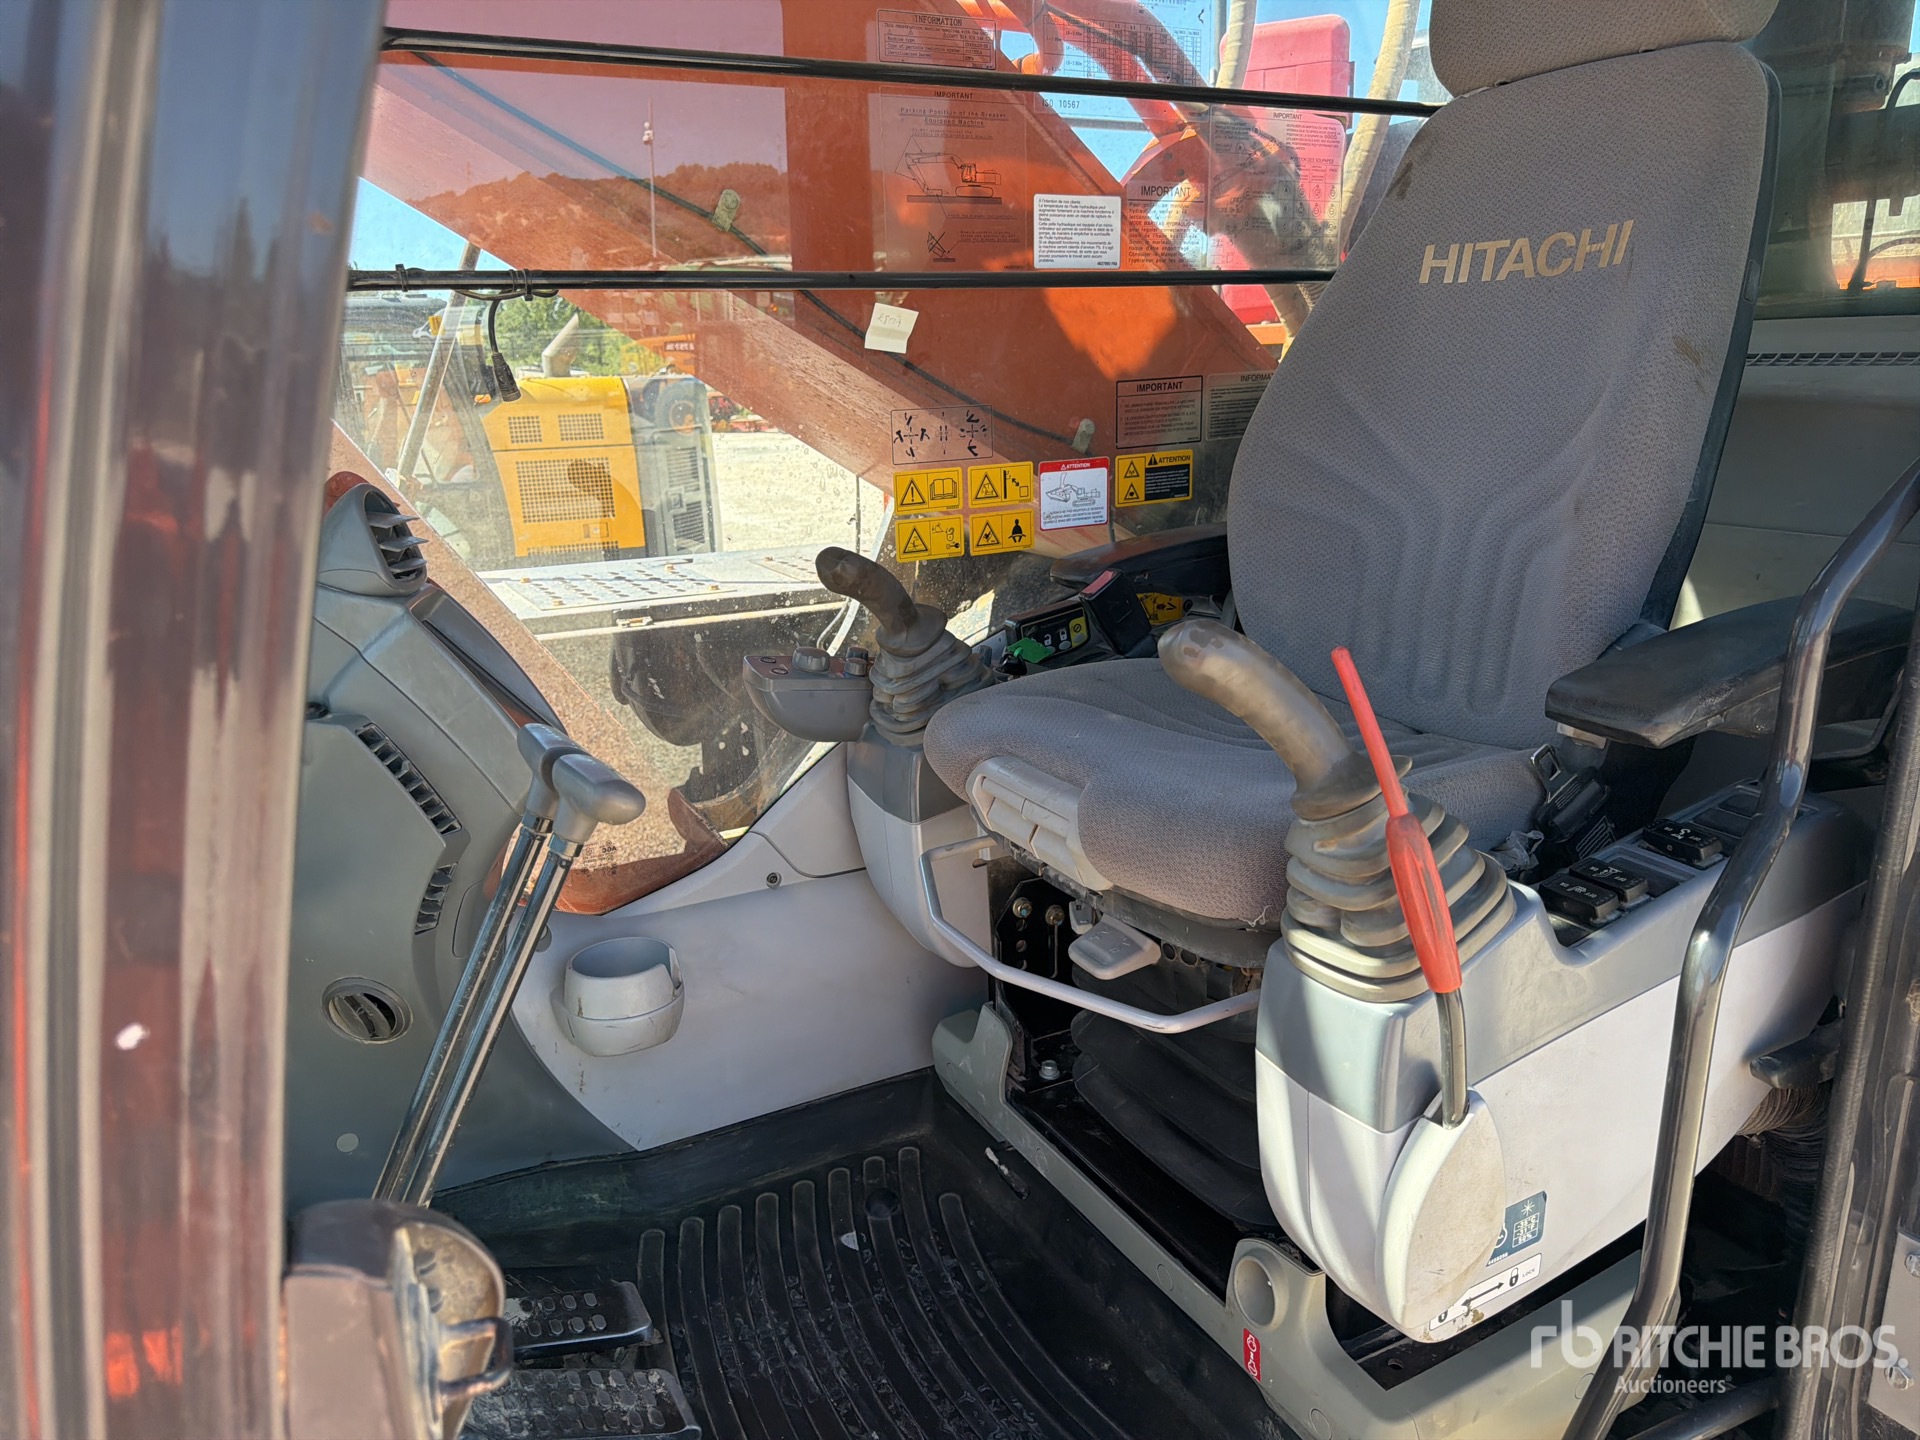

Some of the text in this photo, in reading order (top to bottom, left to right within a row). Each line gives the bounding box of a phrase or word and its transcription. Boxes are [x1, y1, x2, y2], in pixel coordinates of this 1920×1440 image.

[915, 15, 962, 26] INFORMATION
[934, 91, 973, 100] IMPORTANT
[1042, 99, 1080, 109] ISO 10567
[930, 108, 957, 116] Position
[1273, 112, 1303, 120] IMPORTANT
[1141, 186, 1191, 197] IMPORTANT
[1418, 219, 1635, 284] HITACHI
[1136, 381, 1183, 393] IMPORTANT
[1158, 455, 1191, 464] ATTENTION
[1522, 1268, 1535, 1277] LOCK
